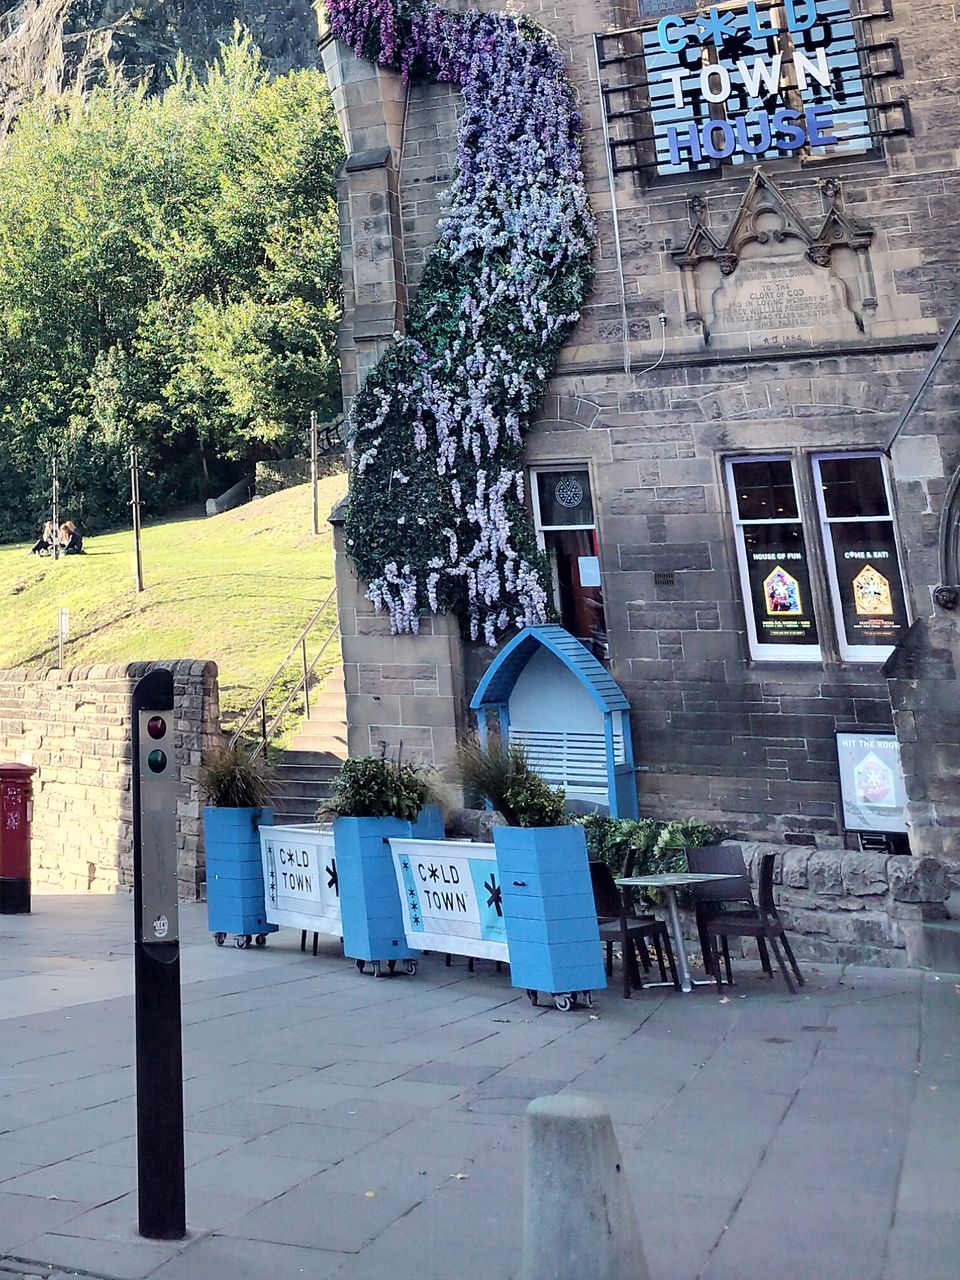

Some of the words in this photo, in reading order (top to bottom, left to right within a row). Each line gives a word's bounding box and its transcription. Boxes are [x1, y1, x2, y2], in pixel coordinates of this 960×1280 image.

[661, 47, 831, 109] TOWN
[667, 104, 838, 165] HOUSE
[859, 740, 875, 748] THE
[282, 872, 312, 893] TOWN
[424, 890, 467, 912] TOWN
